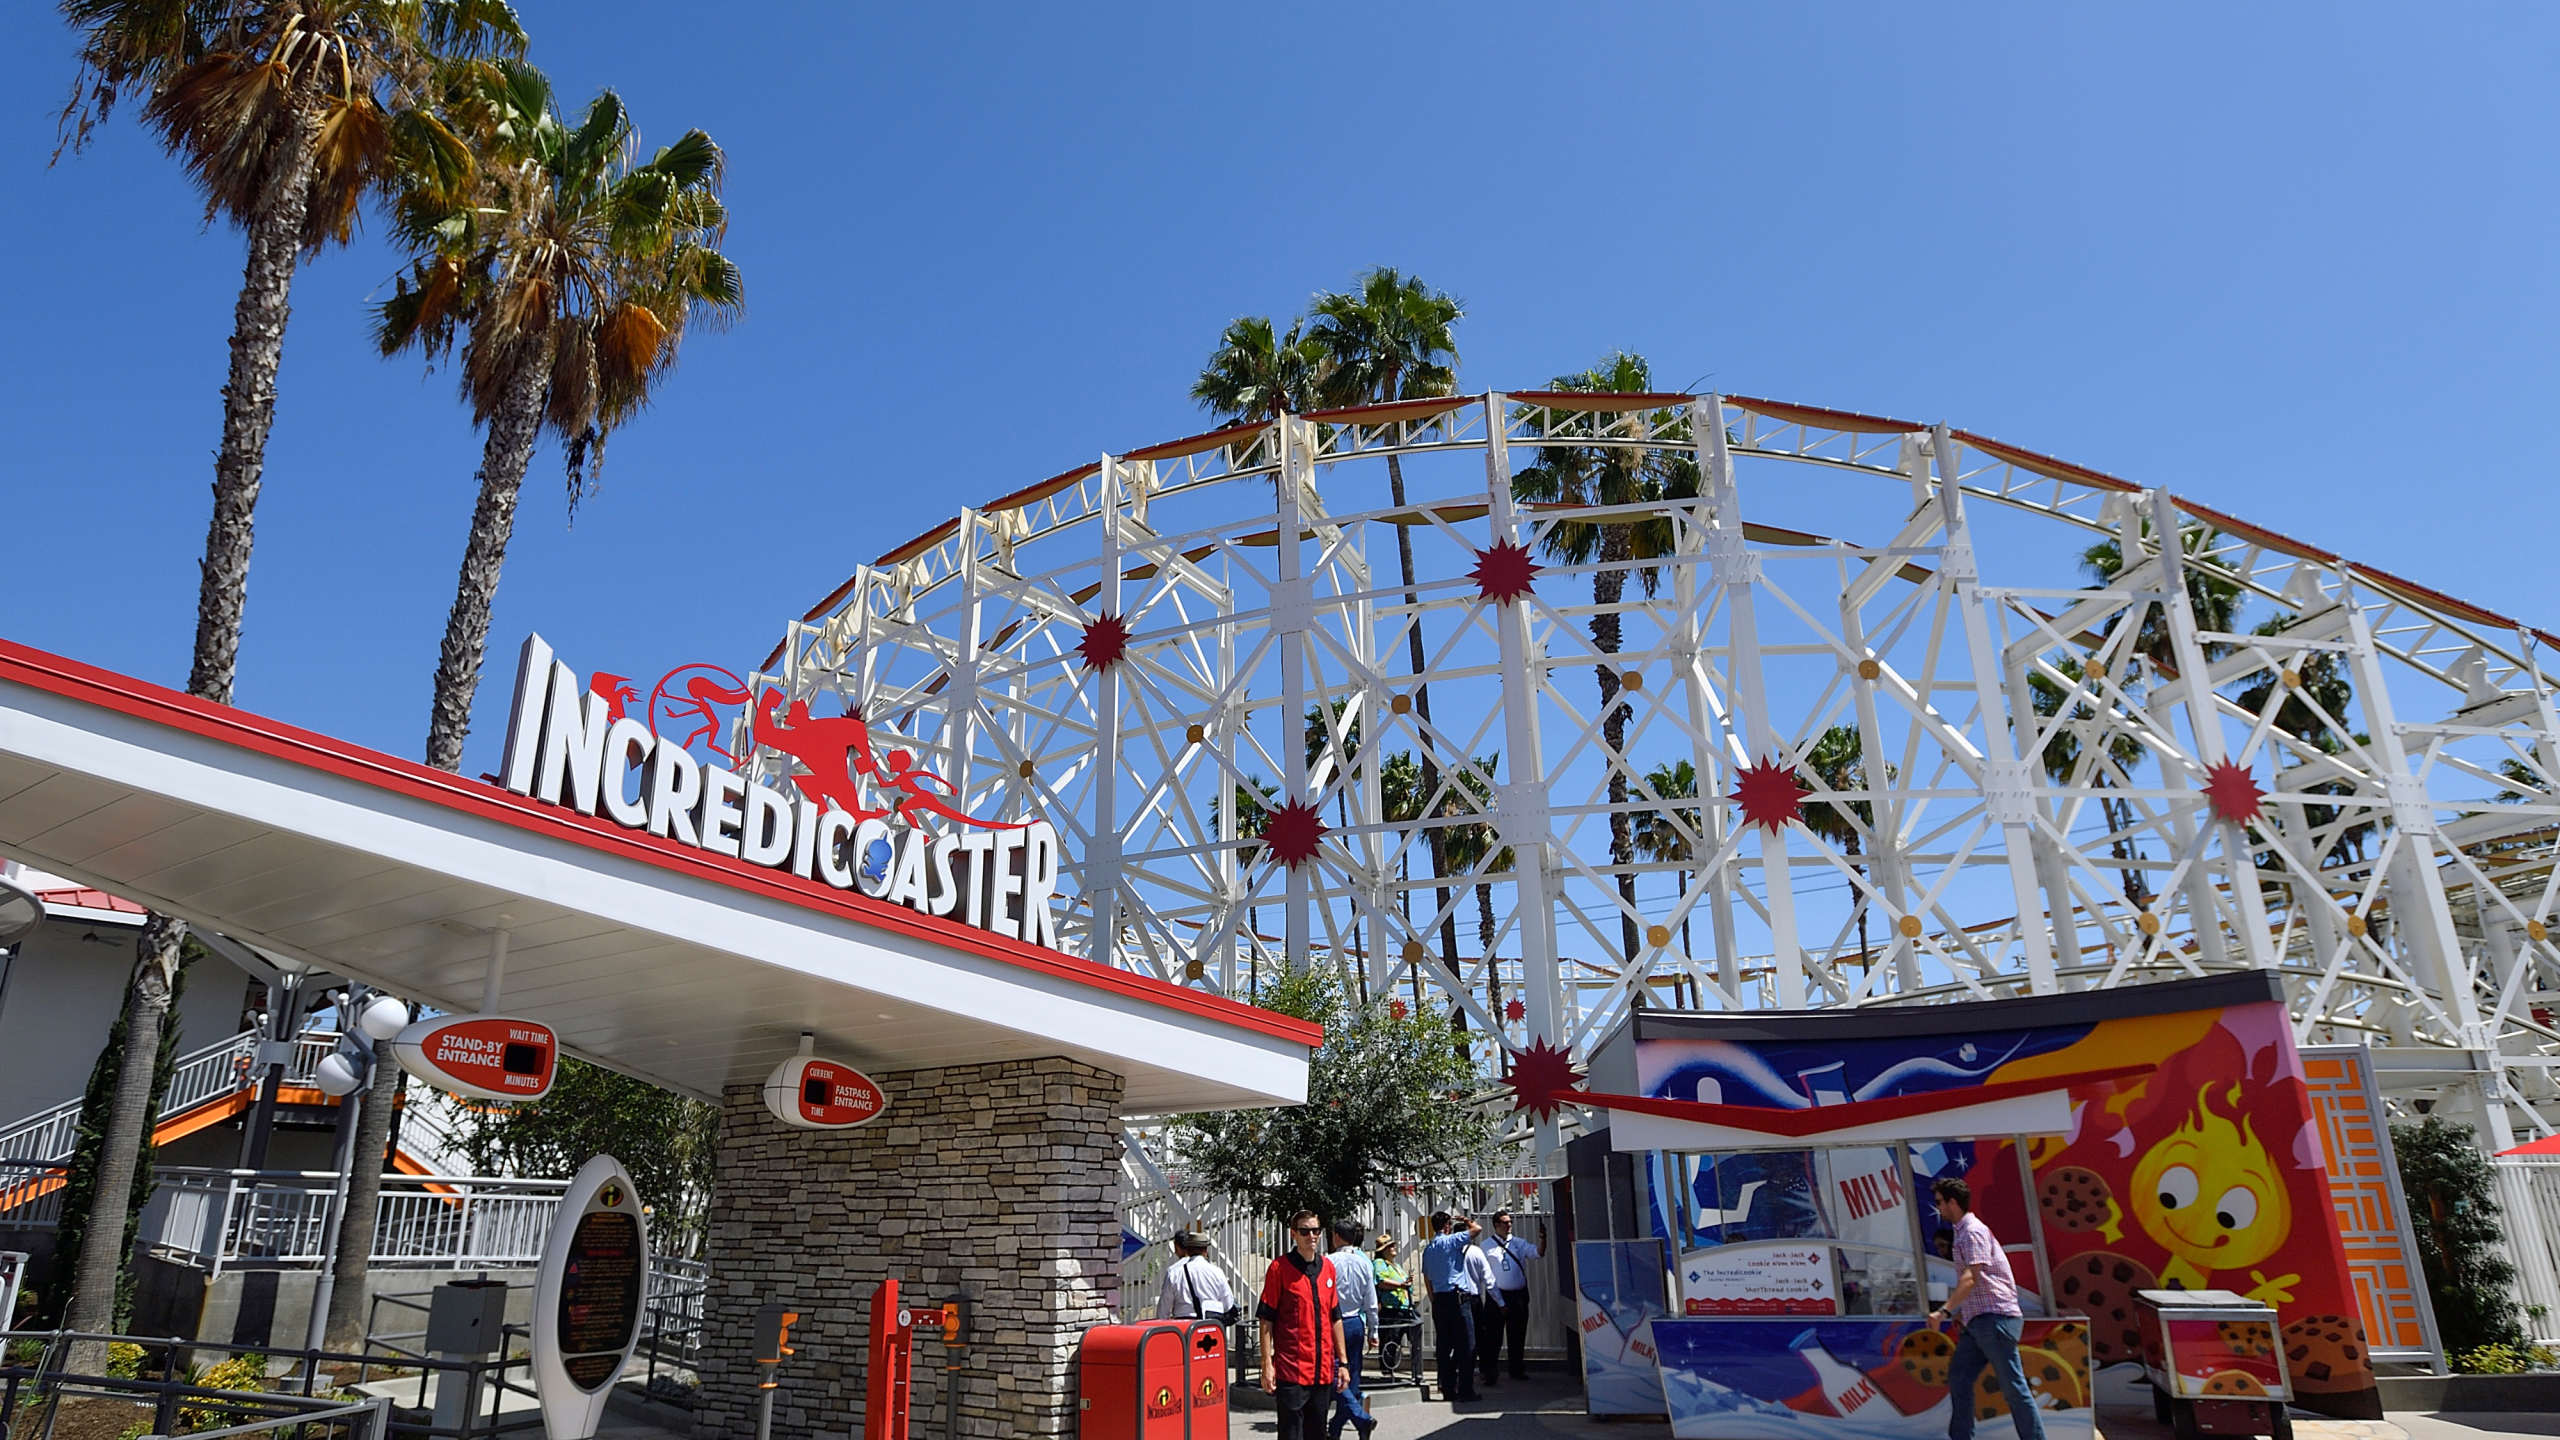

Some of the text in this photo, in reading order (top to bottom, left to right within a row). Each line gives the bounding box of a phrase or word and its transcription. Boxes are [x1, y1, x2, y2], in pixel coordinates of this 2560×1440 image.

[500, 632, 1058, 950] INCREDICOASTER
[441, 1034, 504, 1054] STAND-BY
[509, 1028, 549, 1044] WAIT TIME
[436, 1048, 501, 1067] ENTRANCE
[504, 1074, 539, 1089] MINUTES
[809, 1067, 834, 1080] CURRENT
[835, 1084, 871, 1100] FASTPASS
[810, 1106, 824, 1117] TIME
[834, 1096, 873, 1111] ENTRANCE
[1839, 1165, 1905, 1220] MILK
[1582, 1311, 1609, 1334] MILK
[1630, 1339, 1655, 1360] MILK
[1838, 1378, 1876, 1414] MILK
